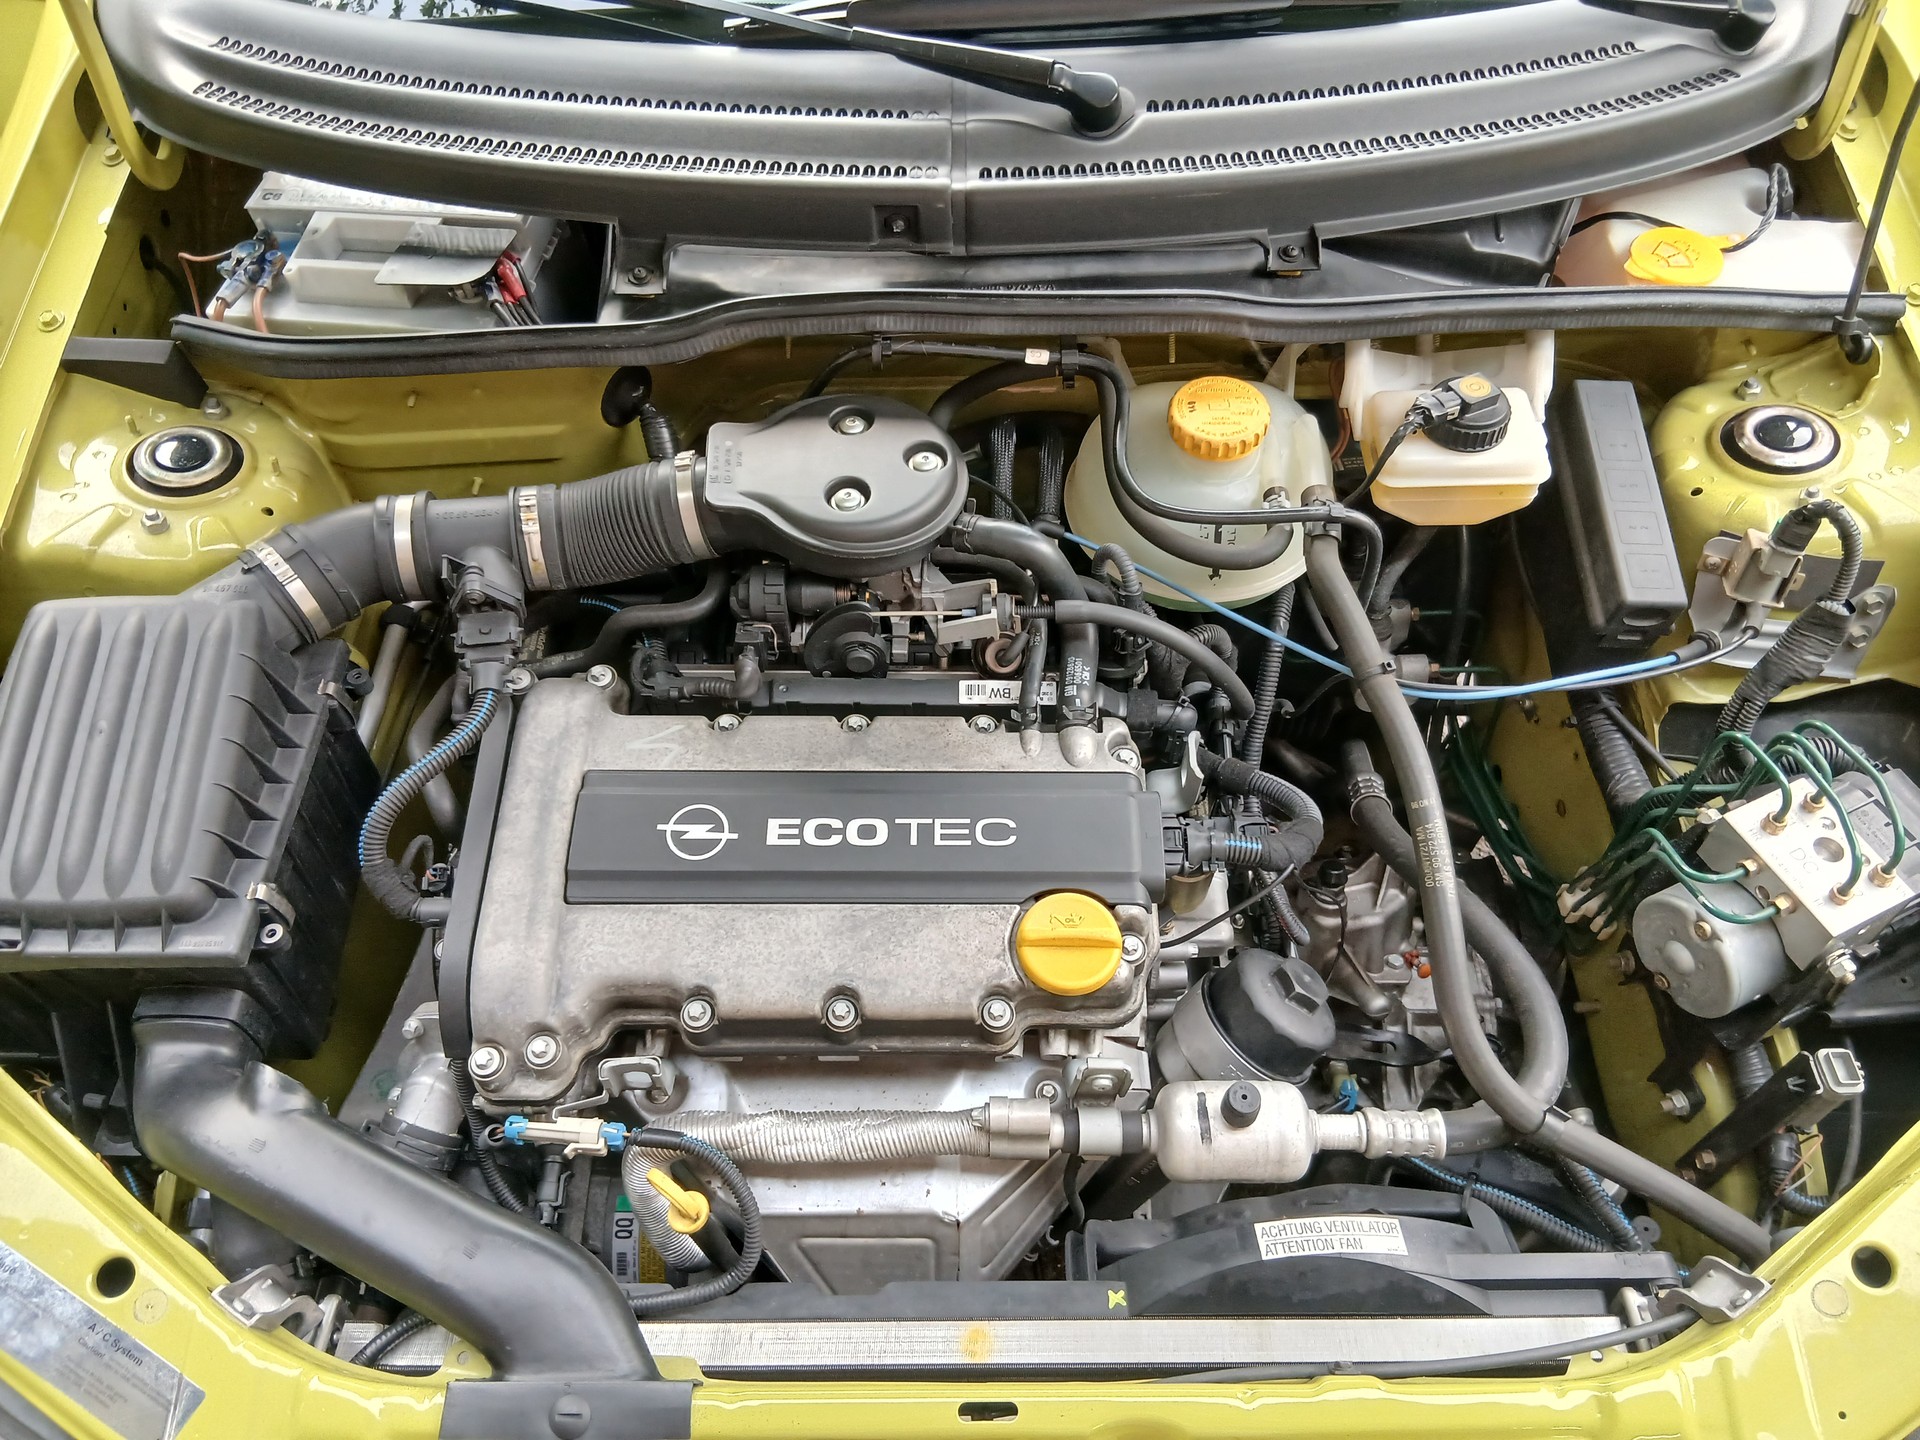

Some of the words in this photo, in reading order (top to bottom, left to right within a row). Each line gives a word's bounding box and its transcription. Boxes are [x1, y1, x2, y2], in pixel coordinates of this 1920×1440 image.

[988, 687, 1011, 699] BW
[766, 817, 1017, 846] ECOTEC
[1429, 841, 1440, 855] 572
[1432, 857, 1441, 868] 90
[615, 1218, 634, 1239] QQ
[1261, 1222, 1322, 1239] ACHTUNG
[1324, 1219, 1399, 1235] VENTILATOR
[1265, 1239, 1334, 1256] ATTENTION
[1340, 1238, 1363, 1250] FAN
[110, 1339, 143, 1367] System
